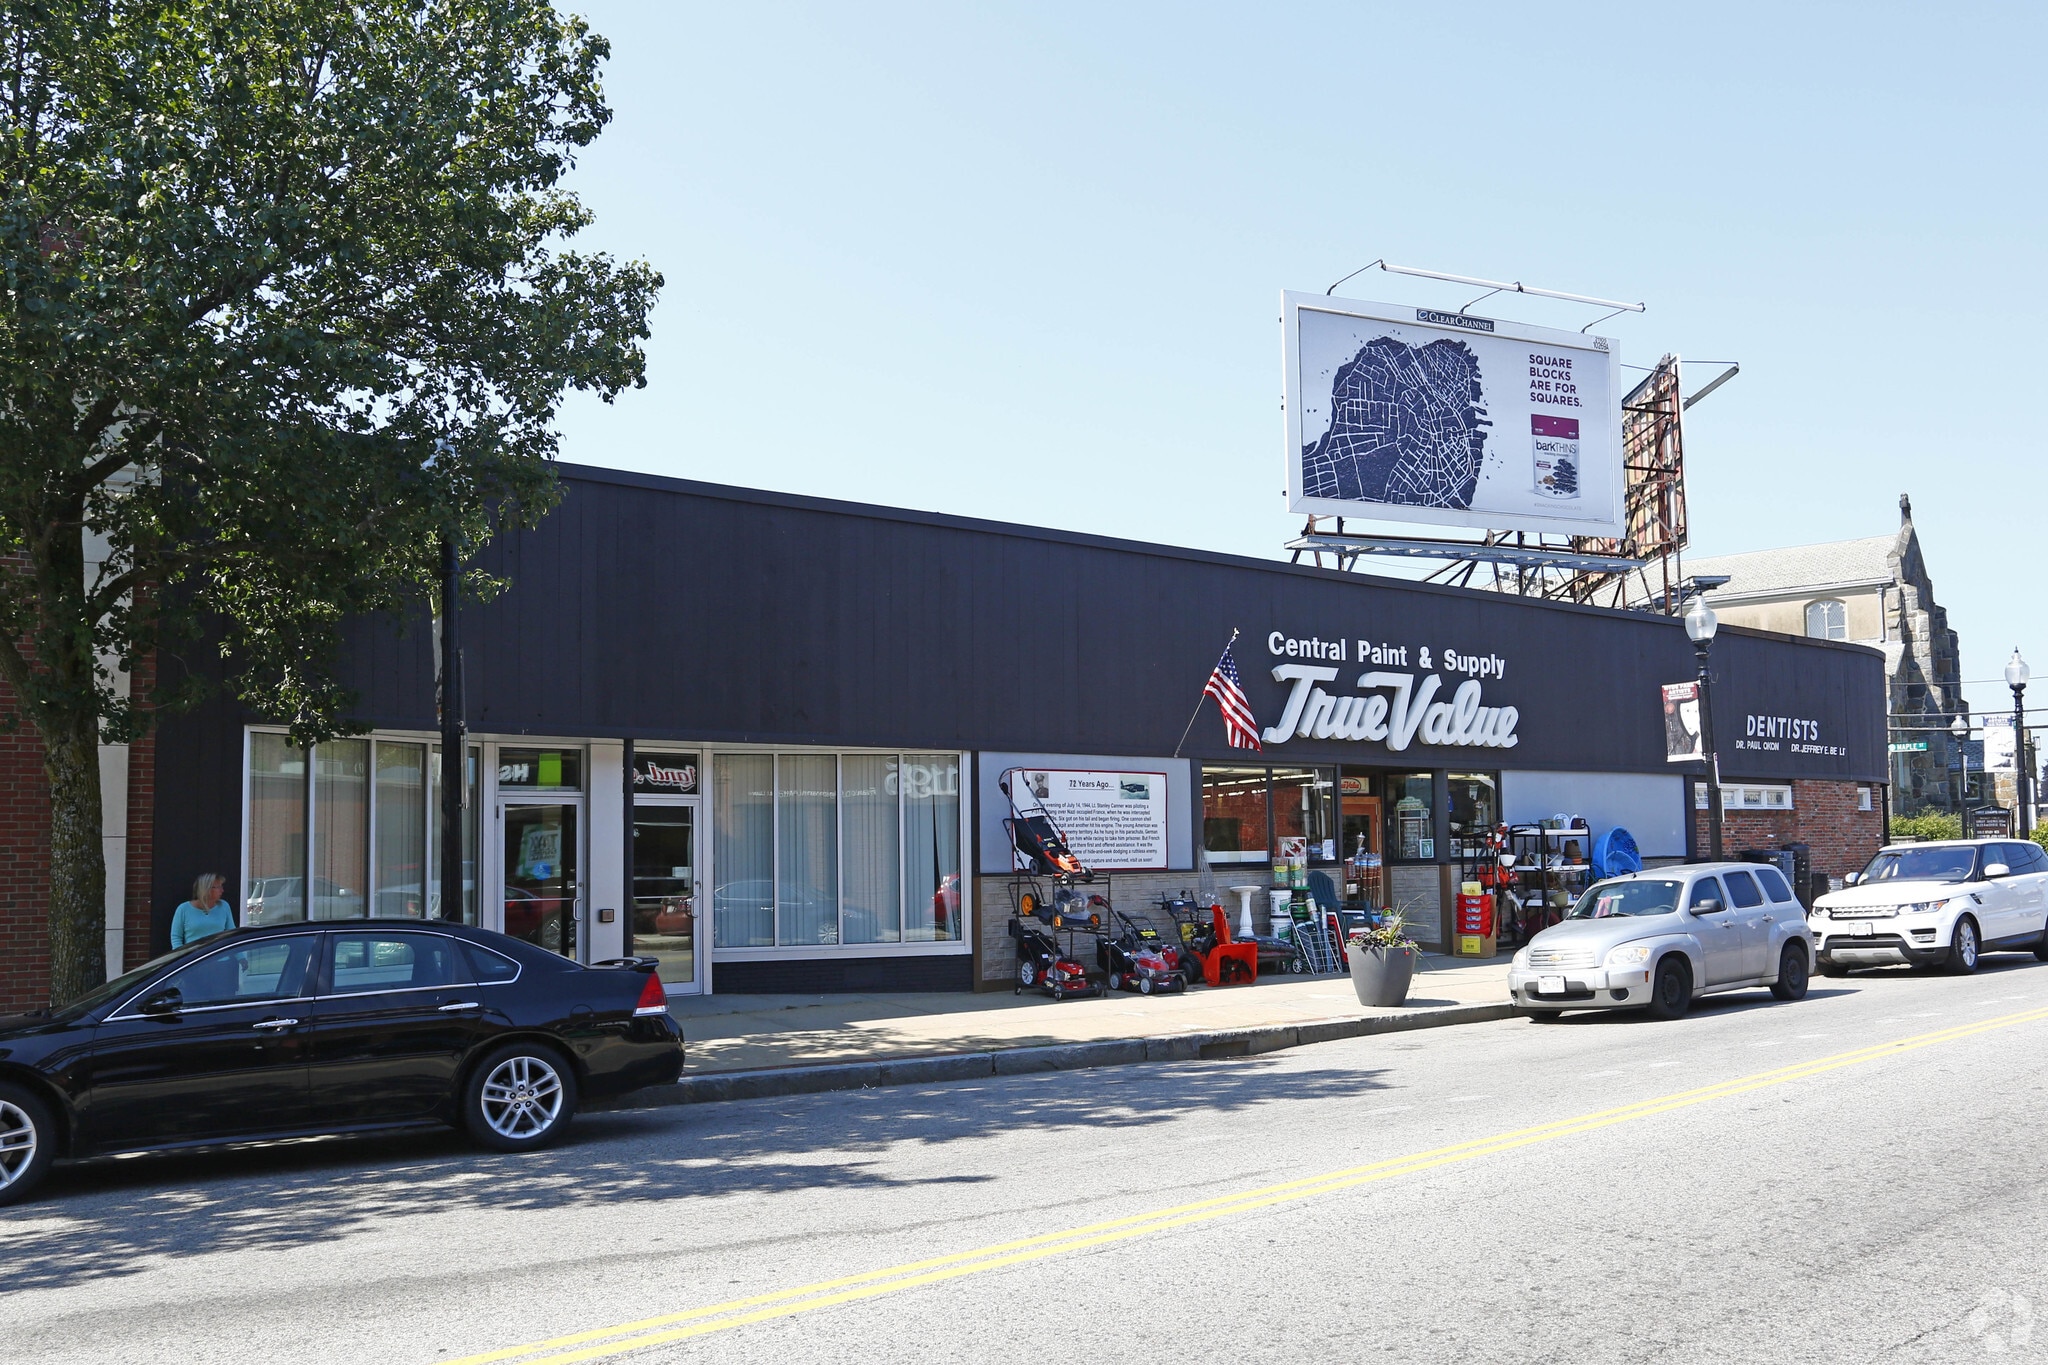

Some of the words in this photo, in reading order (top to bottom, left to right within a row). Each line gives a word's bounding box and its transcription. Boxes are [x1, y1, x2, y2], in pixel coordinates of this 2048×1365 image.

[1529, 354, 1572, 369] SQUARE
[1529, 367, 1571, 381] BLOCKS
[1530, 380, 1551, 391] ARE
[1555, 383, 1576, 394] FOR
[1530, 392, 1582, 407] SQUARES.
[1536, 439, 1576, 454] barkTHINS
[1268, 631, 1346, 661] Central
[1358, 640, 1408, 666] Paint
[1419, 646, 1433, 669] &
[1444, 649, 1505, 679] Supply
[1746, 714, 1818, 741] DENTISTS
[1736, 740, 1745, 749] DR.
[1801, 744, 1823, 754] JEFFREY
